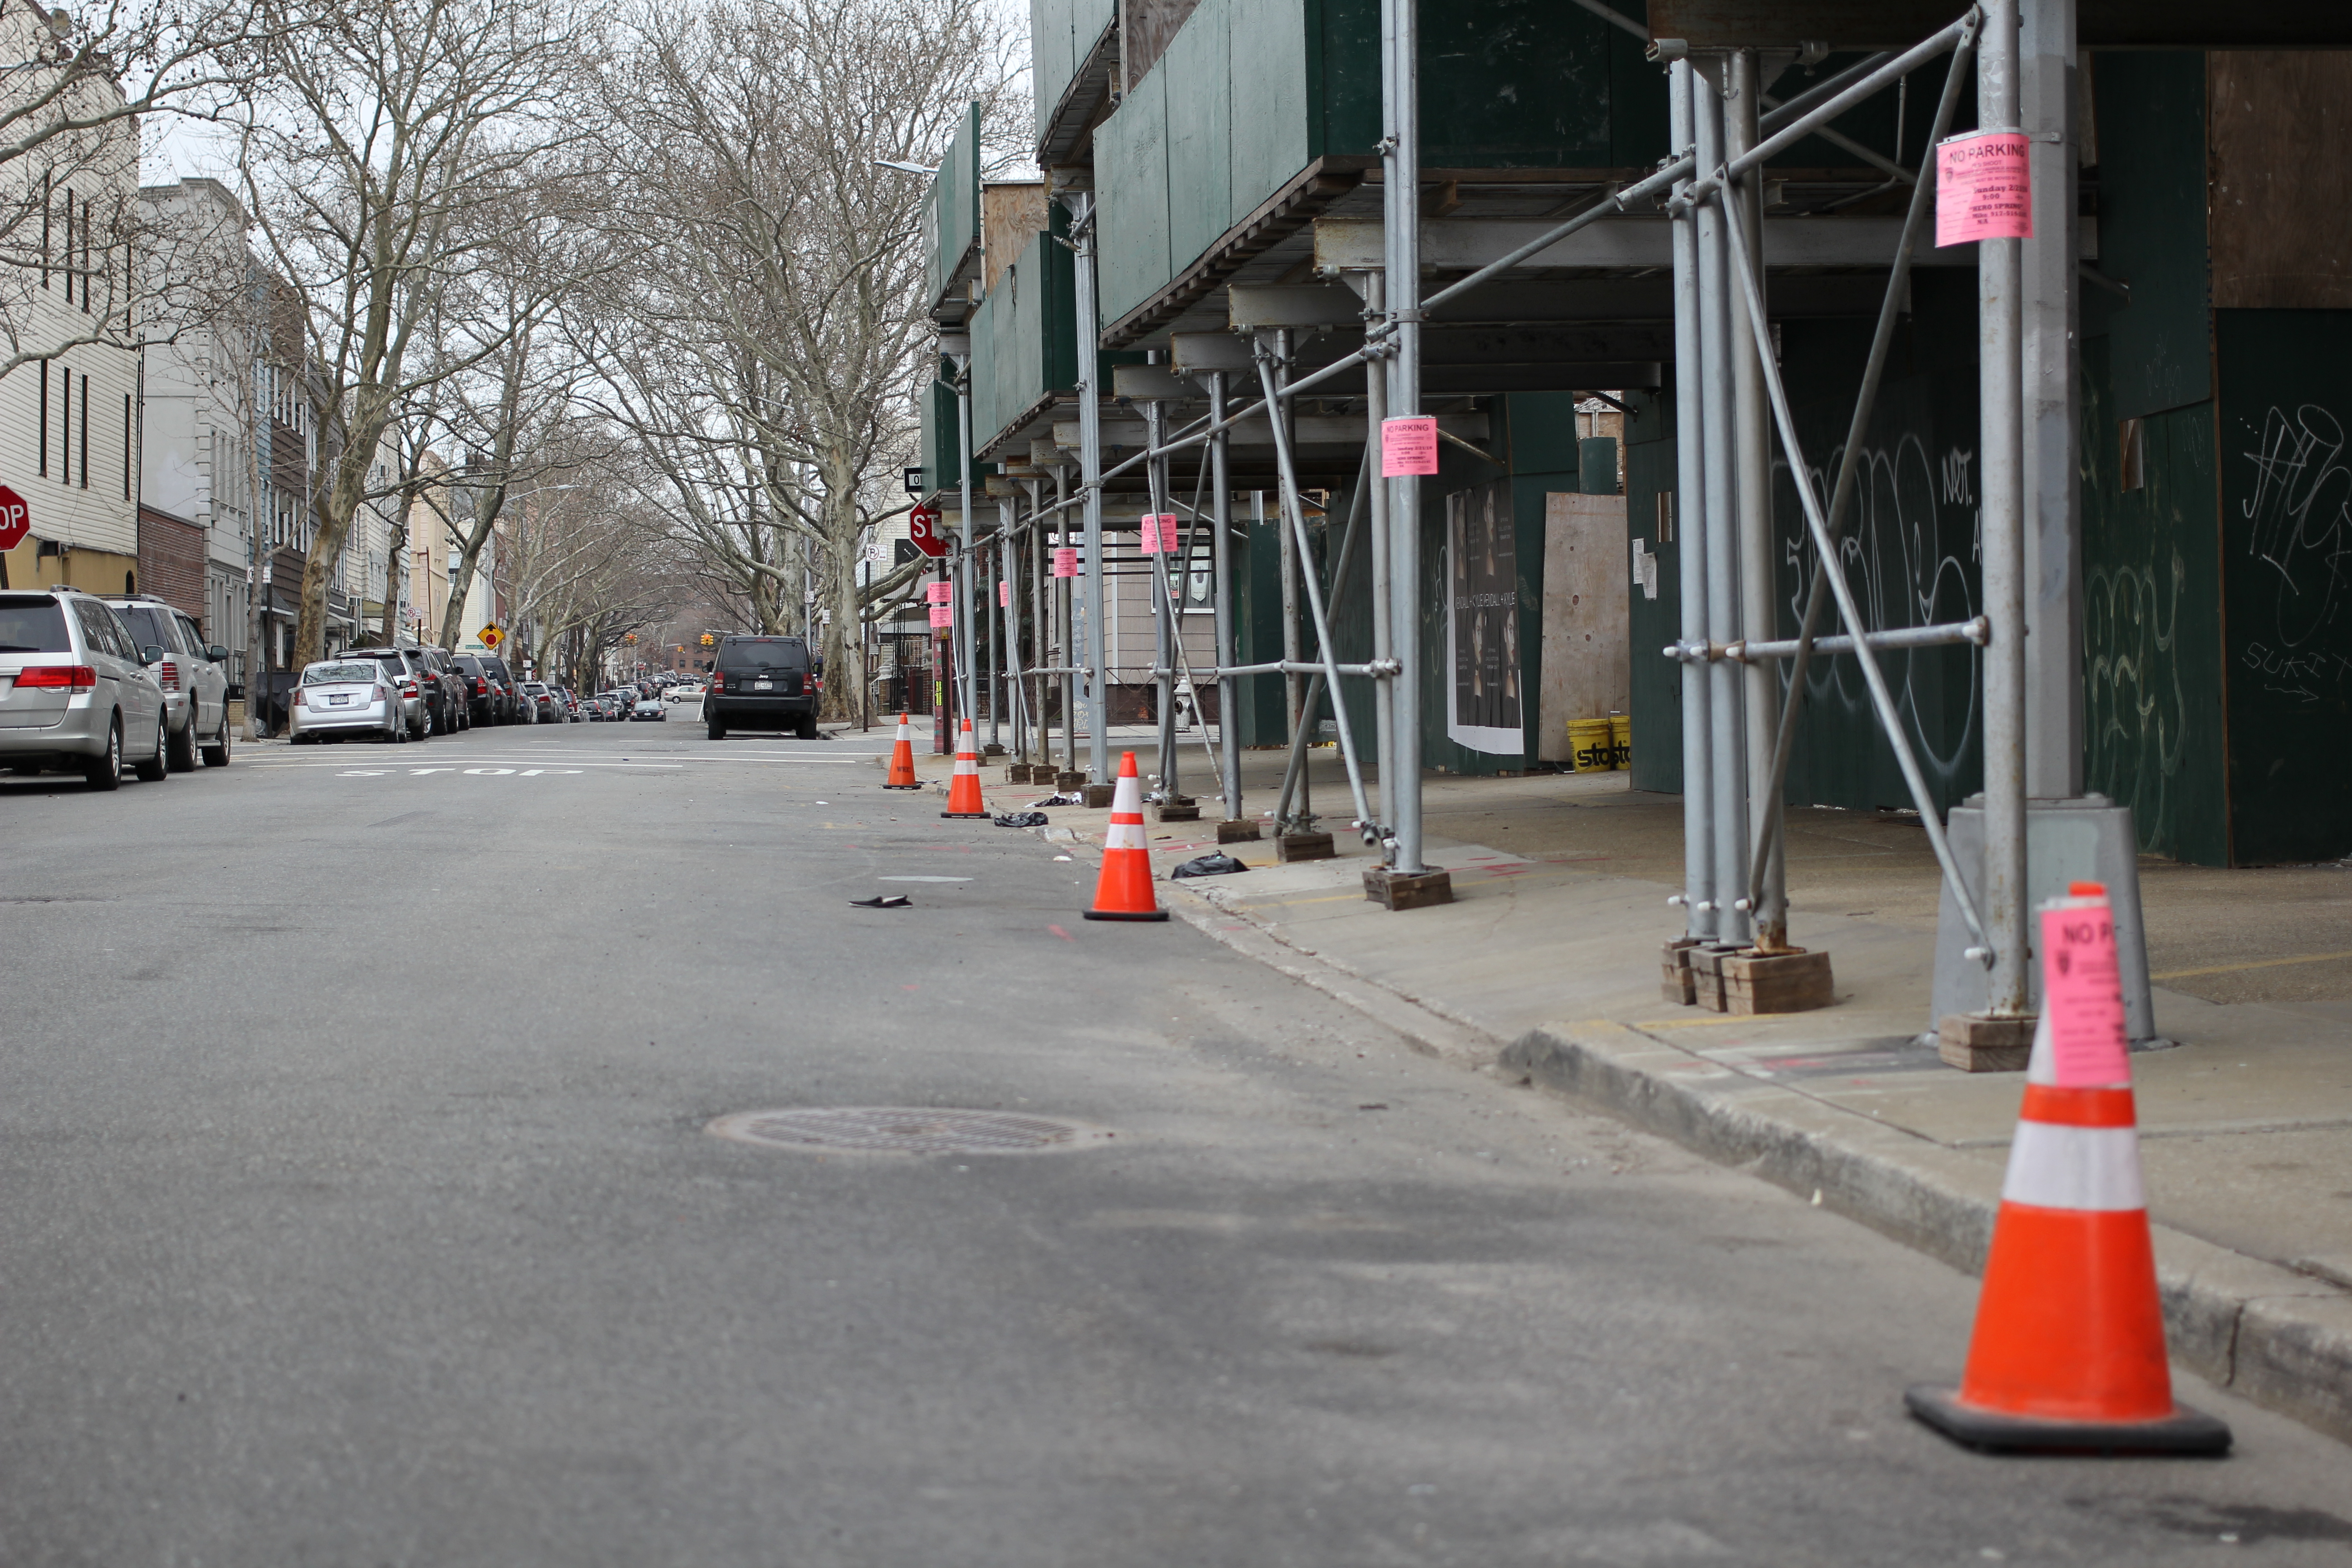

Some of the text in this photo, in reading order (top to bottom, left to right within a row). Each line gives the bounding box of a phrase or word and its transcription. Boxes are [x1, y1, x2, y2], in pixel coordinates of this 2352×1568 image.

[1950, 143, 2025, 164] NO PARKING
[1395, 424, 1429, 432] PARKING
[1504, 592, 1515, 605] KYLE
[1577, 742, 1610, 767] sto
[335, 768, 584, 777] STOP
[2063, 923, 2094, 944] NO
